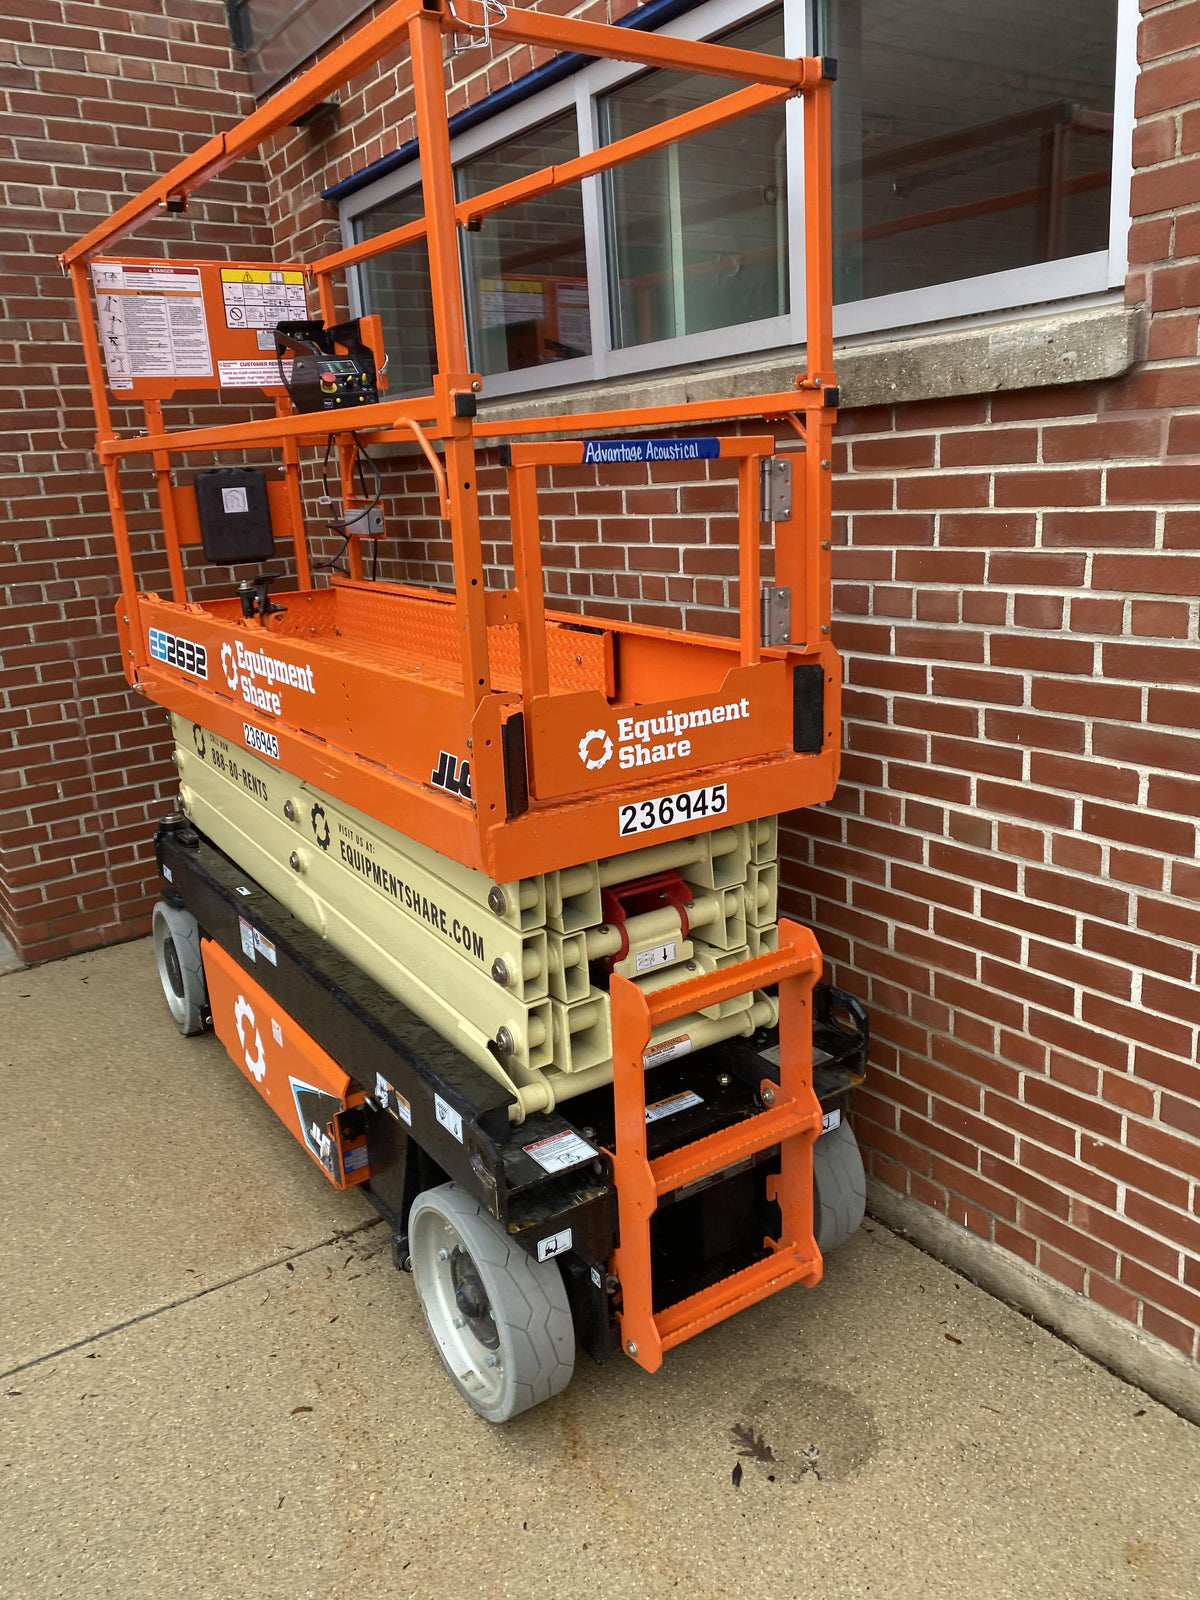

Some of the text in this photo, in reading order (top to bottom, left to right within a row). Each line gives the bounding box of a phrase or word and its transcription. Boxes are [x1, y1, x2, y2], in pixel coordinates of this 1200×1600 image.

[585, 441, 699, 463] Advantage Acoustical
[149, 628, 208, 679] ES2632
[235, 640, 316, 694] Equipment
[240, 675, 282, 716] Share
[244, 724, 279, 758] 236945
[617, 698, 750, 743] Equipment
[211, 748, 268, 801] 888-80-RENTS
[618, 739, 691, 770] Share
[621, 785, 726, 835] 236945
[338, 823, 375, 854] VISIT US AT:
[339, 839, 485, 962] EQUIPMENTSHARE.COM
